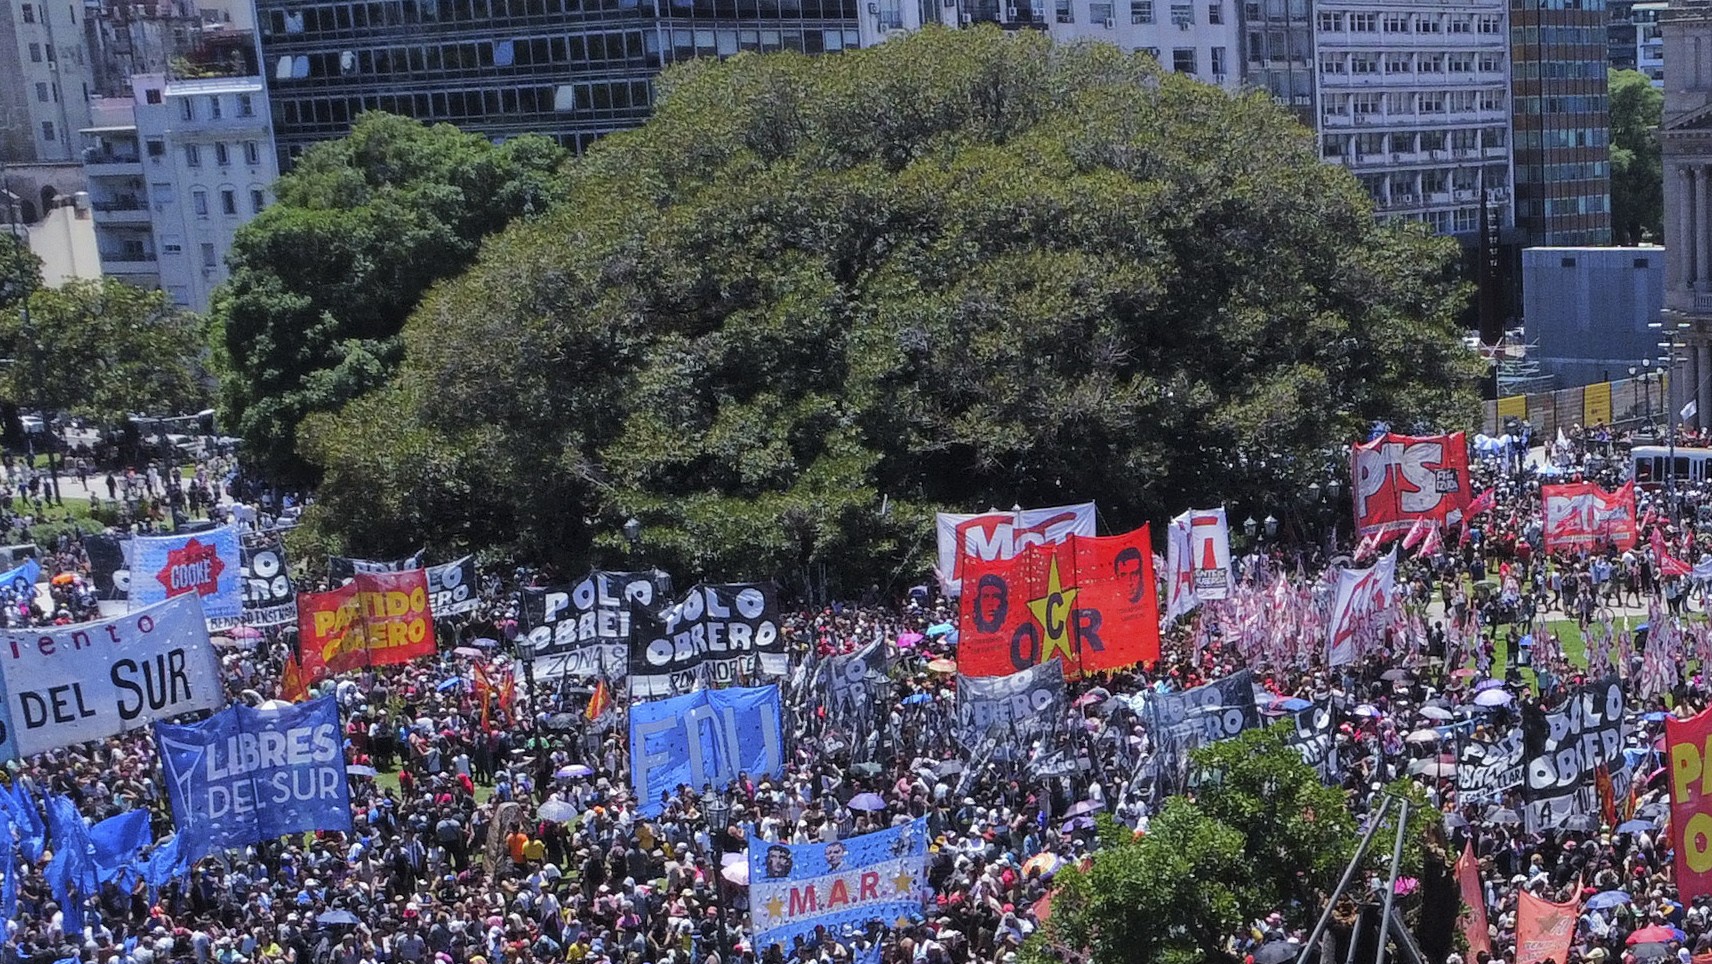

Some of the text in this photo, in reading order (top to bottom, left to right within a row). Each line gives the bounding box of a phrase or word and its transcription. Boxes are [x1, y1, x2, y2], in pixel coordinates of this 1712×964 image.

[1358, 443, 1443, 519] PTS
[171, 560, 213, 590] COOKE
[545, 570, 653, 624] POLO
[527, 608, 631, 651] OBRE
[657, 586, 766, 635] POLO
[646, 620, 778, 667] OBRERO
[19, 648, 193, 730] DEL SUR
[206, 722, 338, 782] LIBRES
[1529, 727, 1625, 790] OBRER
[207, 766, 340, 820] DEL SUR
